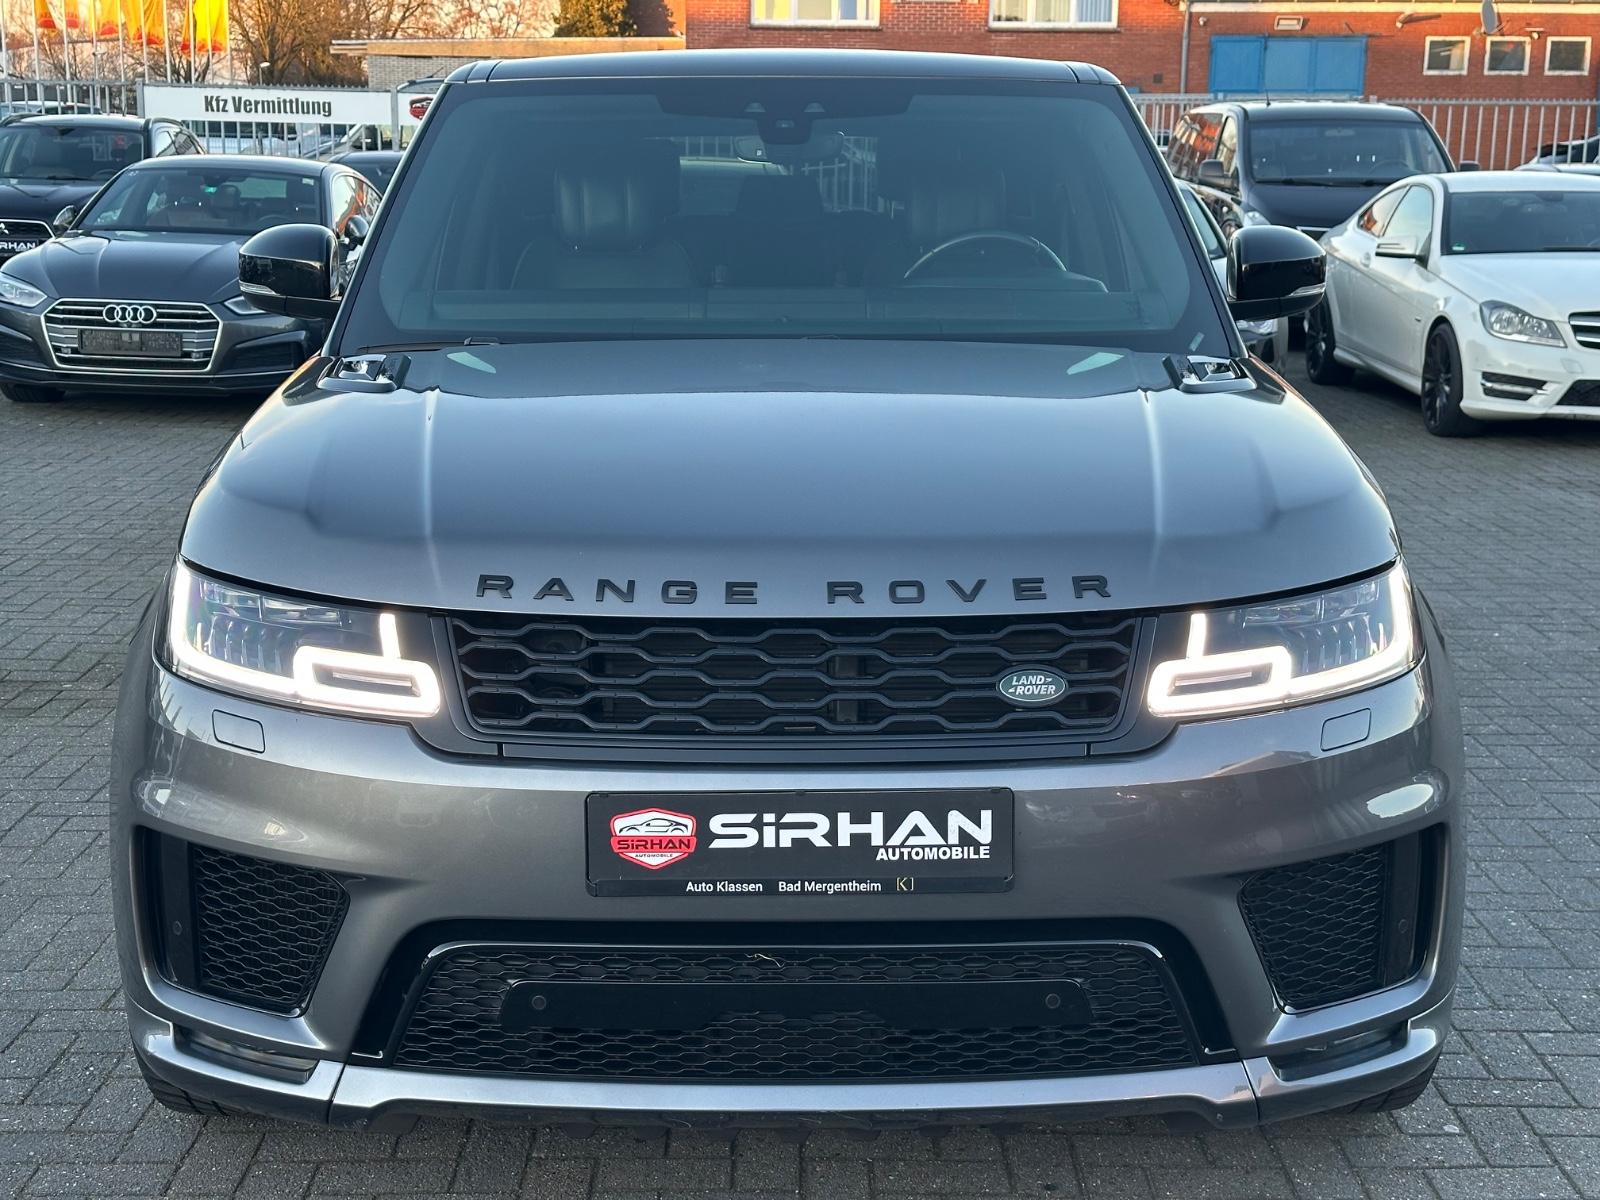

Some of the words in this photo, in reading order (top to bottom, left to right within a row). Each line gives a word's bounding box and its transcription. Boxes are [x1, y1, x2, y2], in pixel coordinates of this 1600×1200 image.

[204, 95, 228, 112] Kfz
[231, 96, 331, 117] Vermittlung
[476, 574, 758, 604] RANGE
[827, 575, 1111, 604] ROVER
[1012, 675, 1045, 685] LAND
[1016, 684, 1056, 695] ROVER
[876, 846, 990, 861] AUTOMOBILE
[686, 881, 714, 892] Auto
[717, 880, 763, 892] Klassen
[778, 880, 801, 892] Bad
[804, 880, 882, 895] Mergentheim
